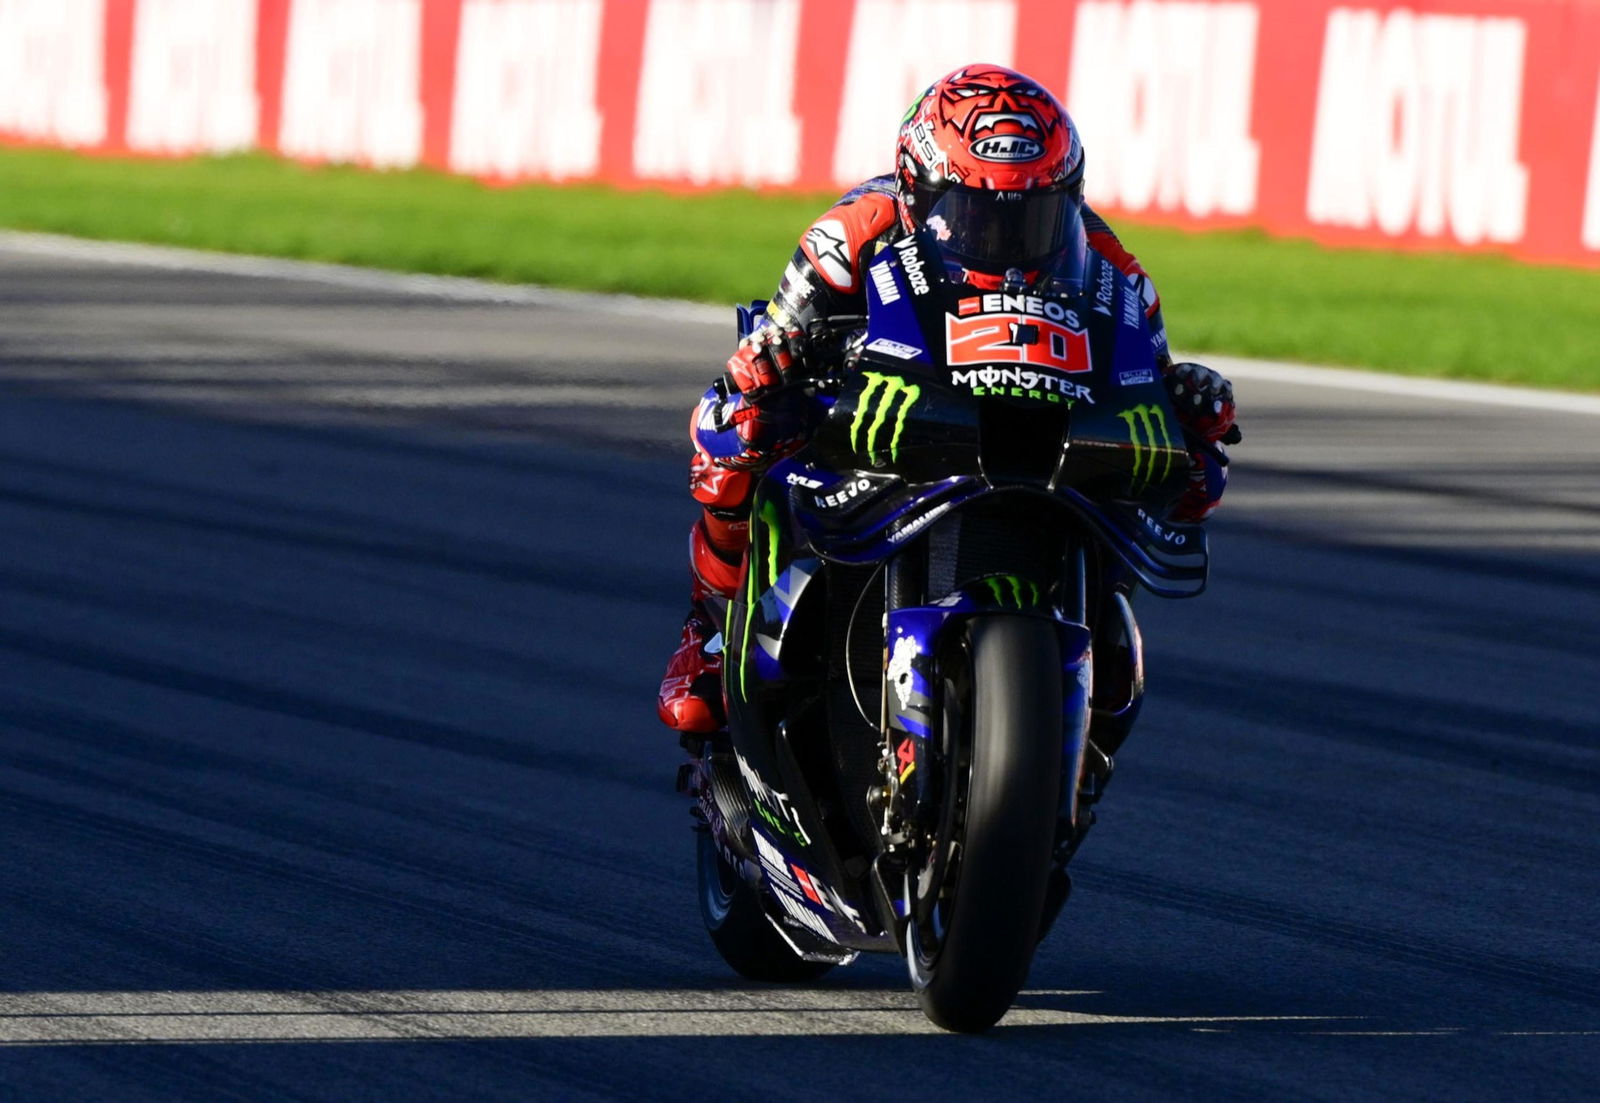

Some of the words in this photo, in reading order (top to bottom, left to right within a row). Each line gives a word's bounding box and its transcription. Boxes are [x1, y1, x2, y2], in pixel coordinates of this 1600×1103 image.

[980, 141, 1036, 154] HJC
[869, 260, 901, 305] YAMAHA
[898, 245, 930, 297] Roboze
[1095, 259, 1114, 306] Roboze
[982, 294, 1080, 328] ENEOS
[945, 312, 1093, 374] 20
[951, 366, 1095, 404] MONSTER
[973, 386, 1076, 409] ENERGY
